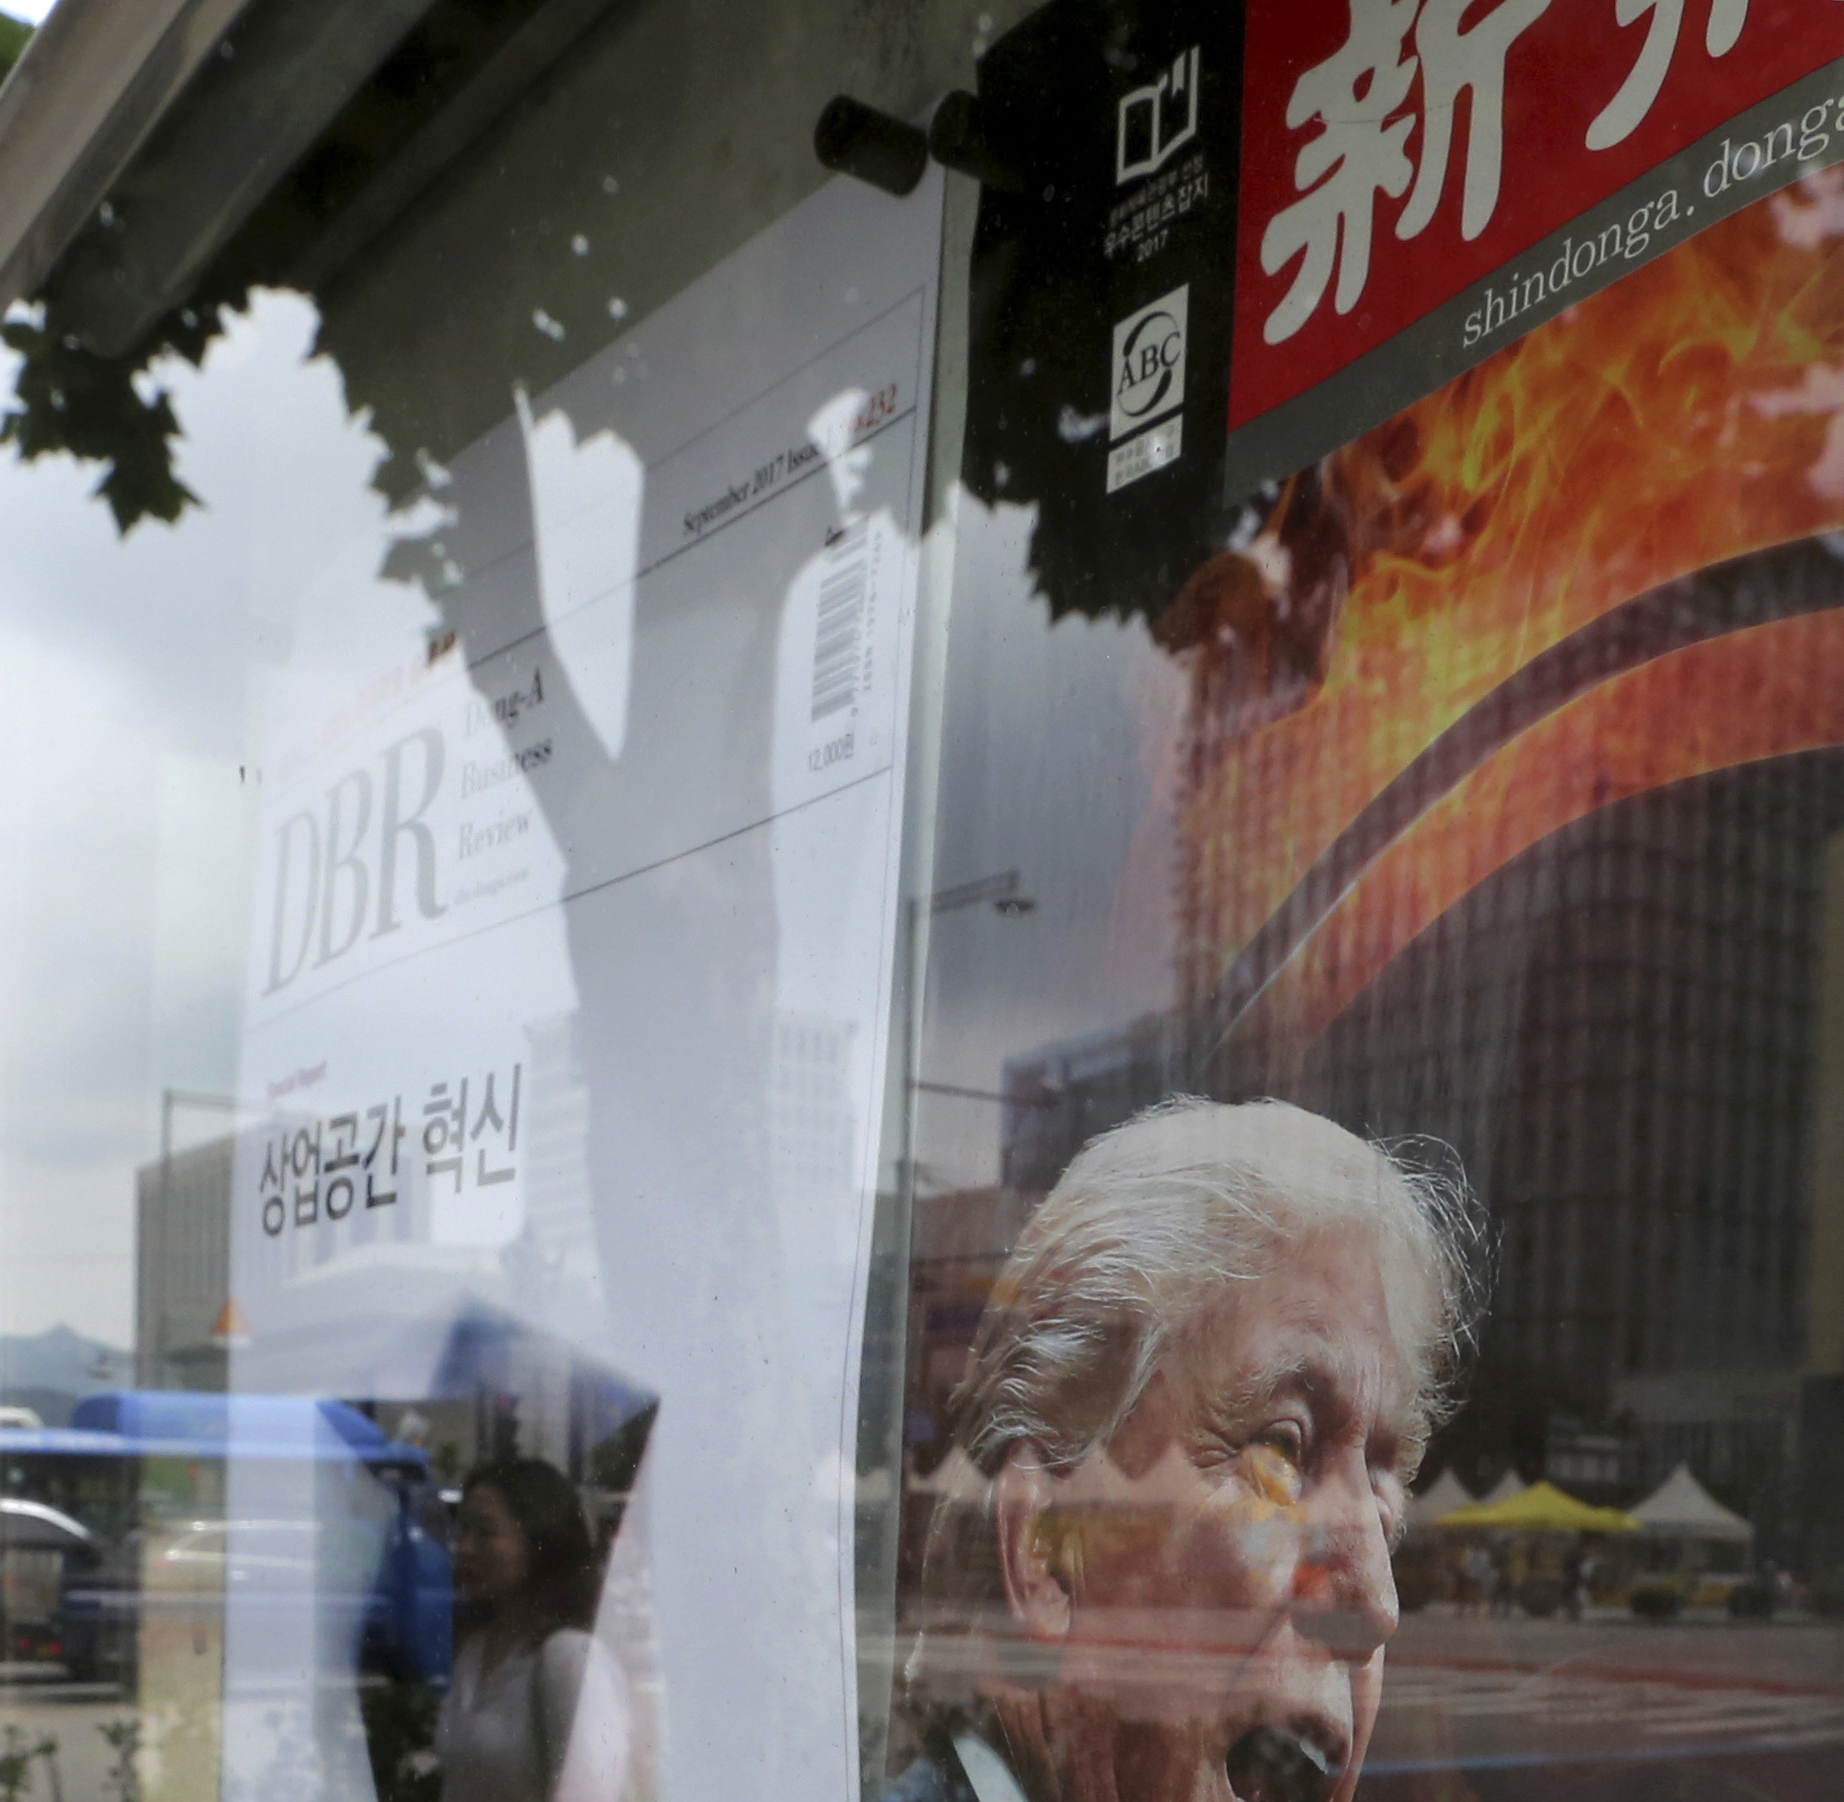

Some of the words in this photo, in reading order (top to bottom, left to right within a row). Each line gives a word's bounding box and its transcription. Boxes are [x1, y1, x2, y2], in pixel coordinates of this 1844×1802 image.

[1136, 229, 1169, 263] 2017
[1117, 331, 1181, 395] ABC
[262, 725, 448, 999] DBR
[259, 1095, 406, 1237] 상업공간
[422, 1062, 523, 1193] 혁신
